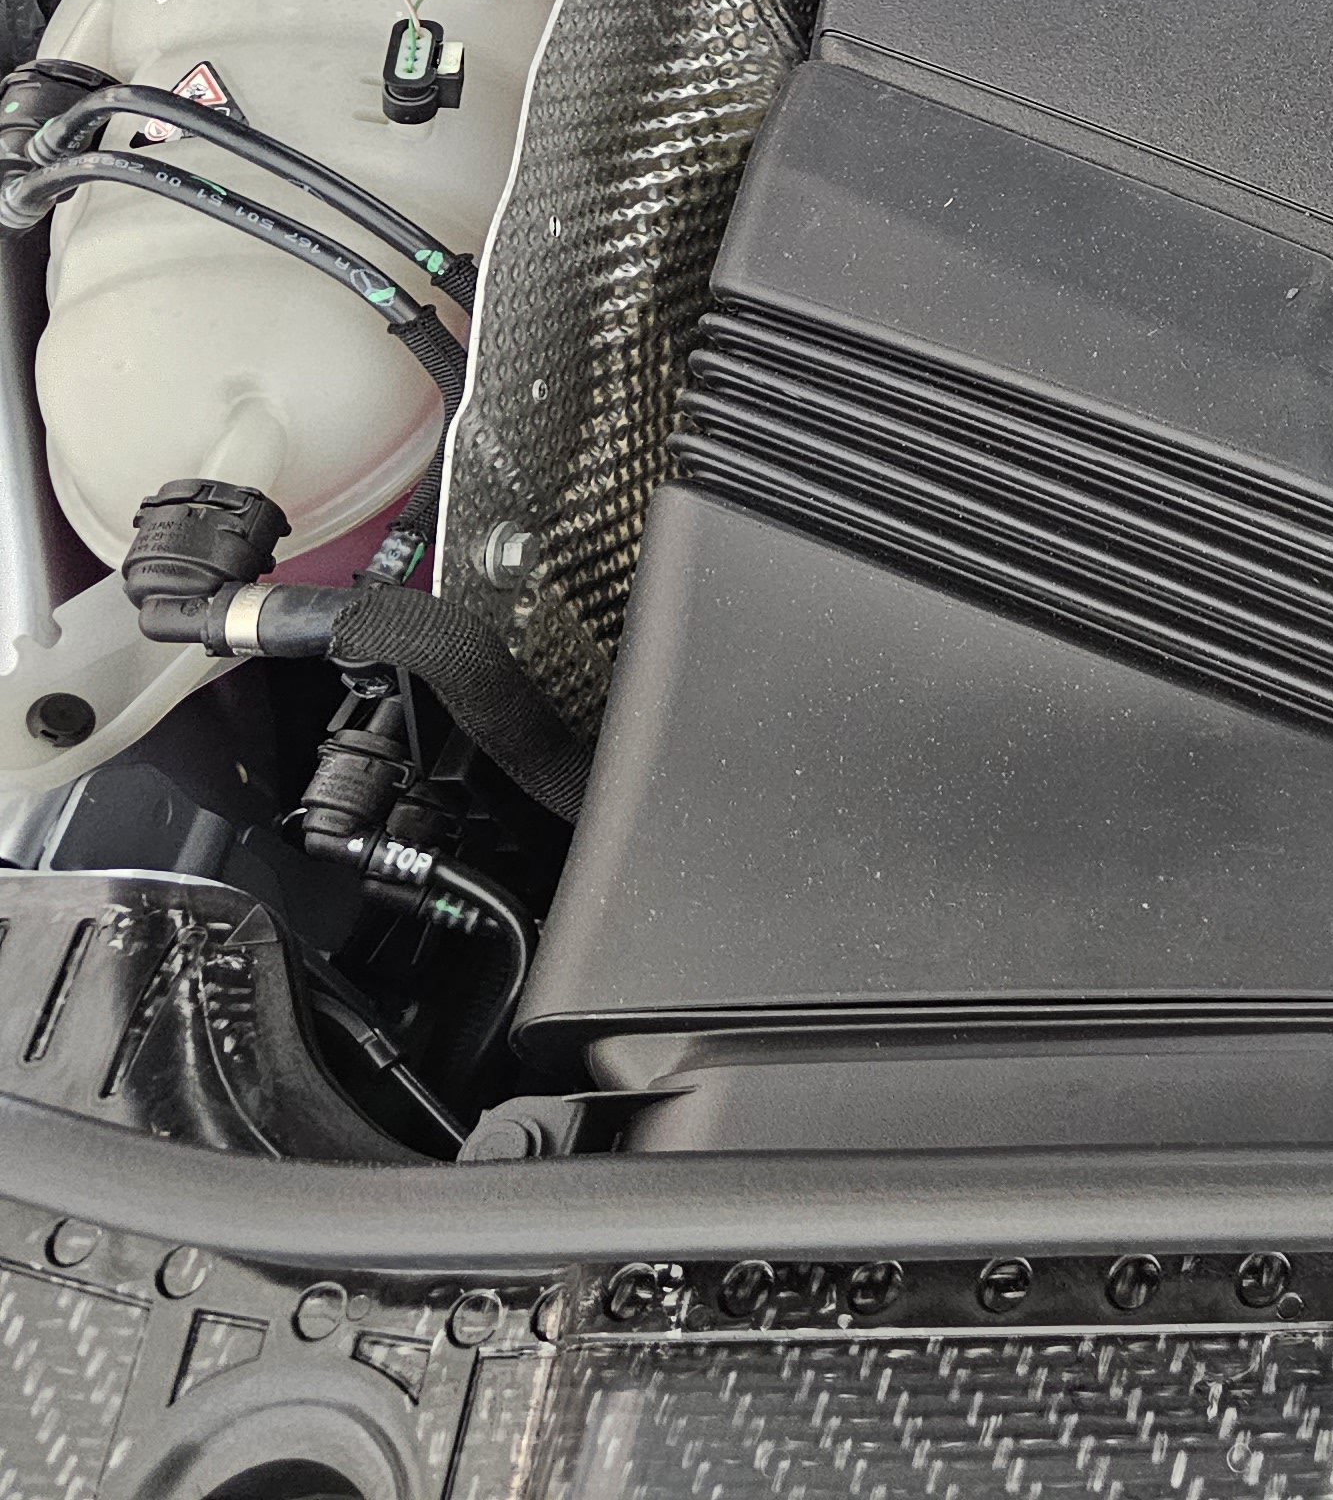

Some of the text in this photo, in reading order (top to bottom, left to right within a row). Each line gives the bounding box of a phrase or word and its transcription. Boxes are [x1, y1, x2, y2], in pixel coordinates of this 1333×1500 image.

[155, 171, 182, 188] 00
[196, 187, 224, 208] 51
[234, 206, 275, 232] 501
[384, 841, 433, 875] TOP
